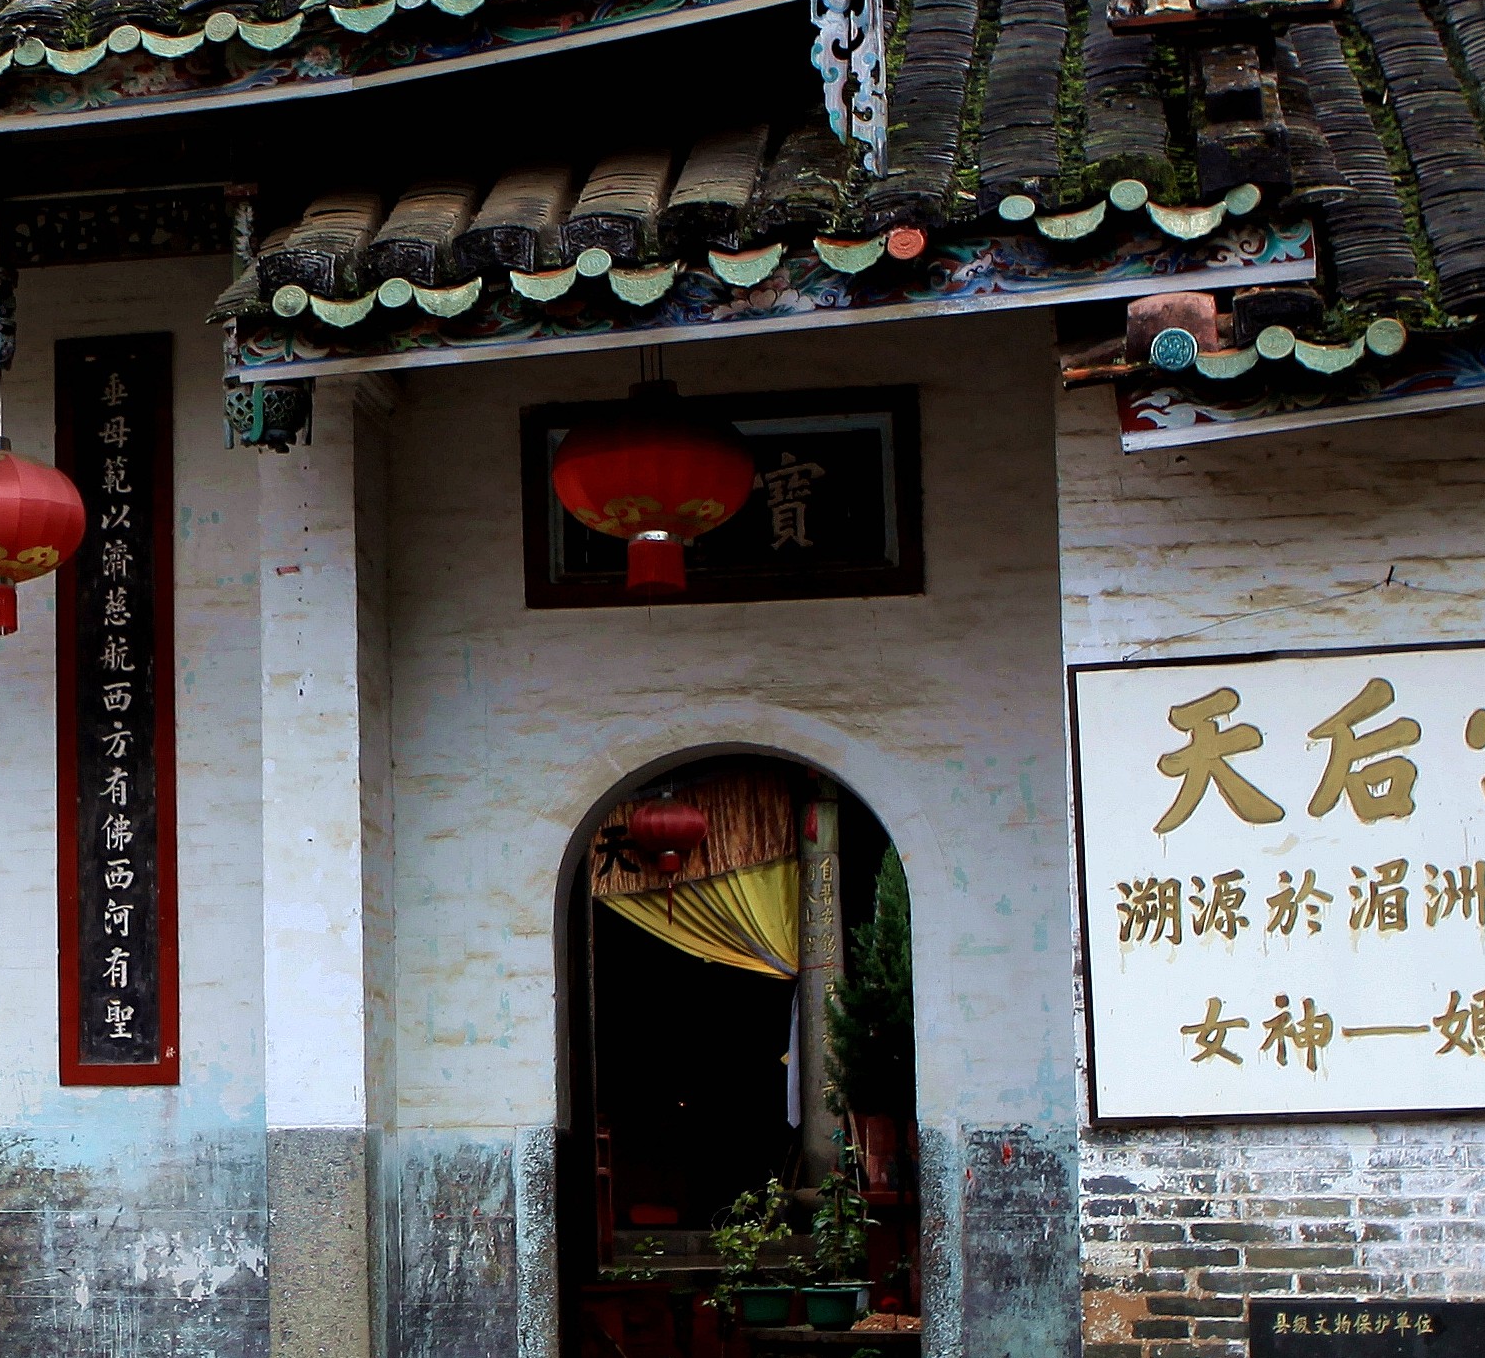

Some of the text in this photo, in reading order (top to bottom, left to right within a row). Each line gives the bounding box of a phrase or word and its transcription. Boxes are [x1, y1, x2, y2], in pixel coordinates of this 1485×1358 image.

[1272, 1311, 1434, 1338] 县级文物保护单位
